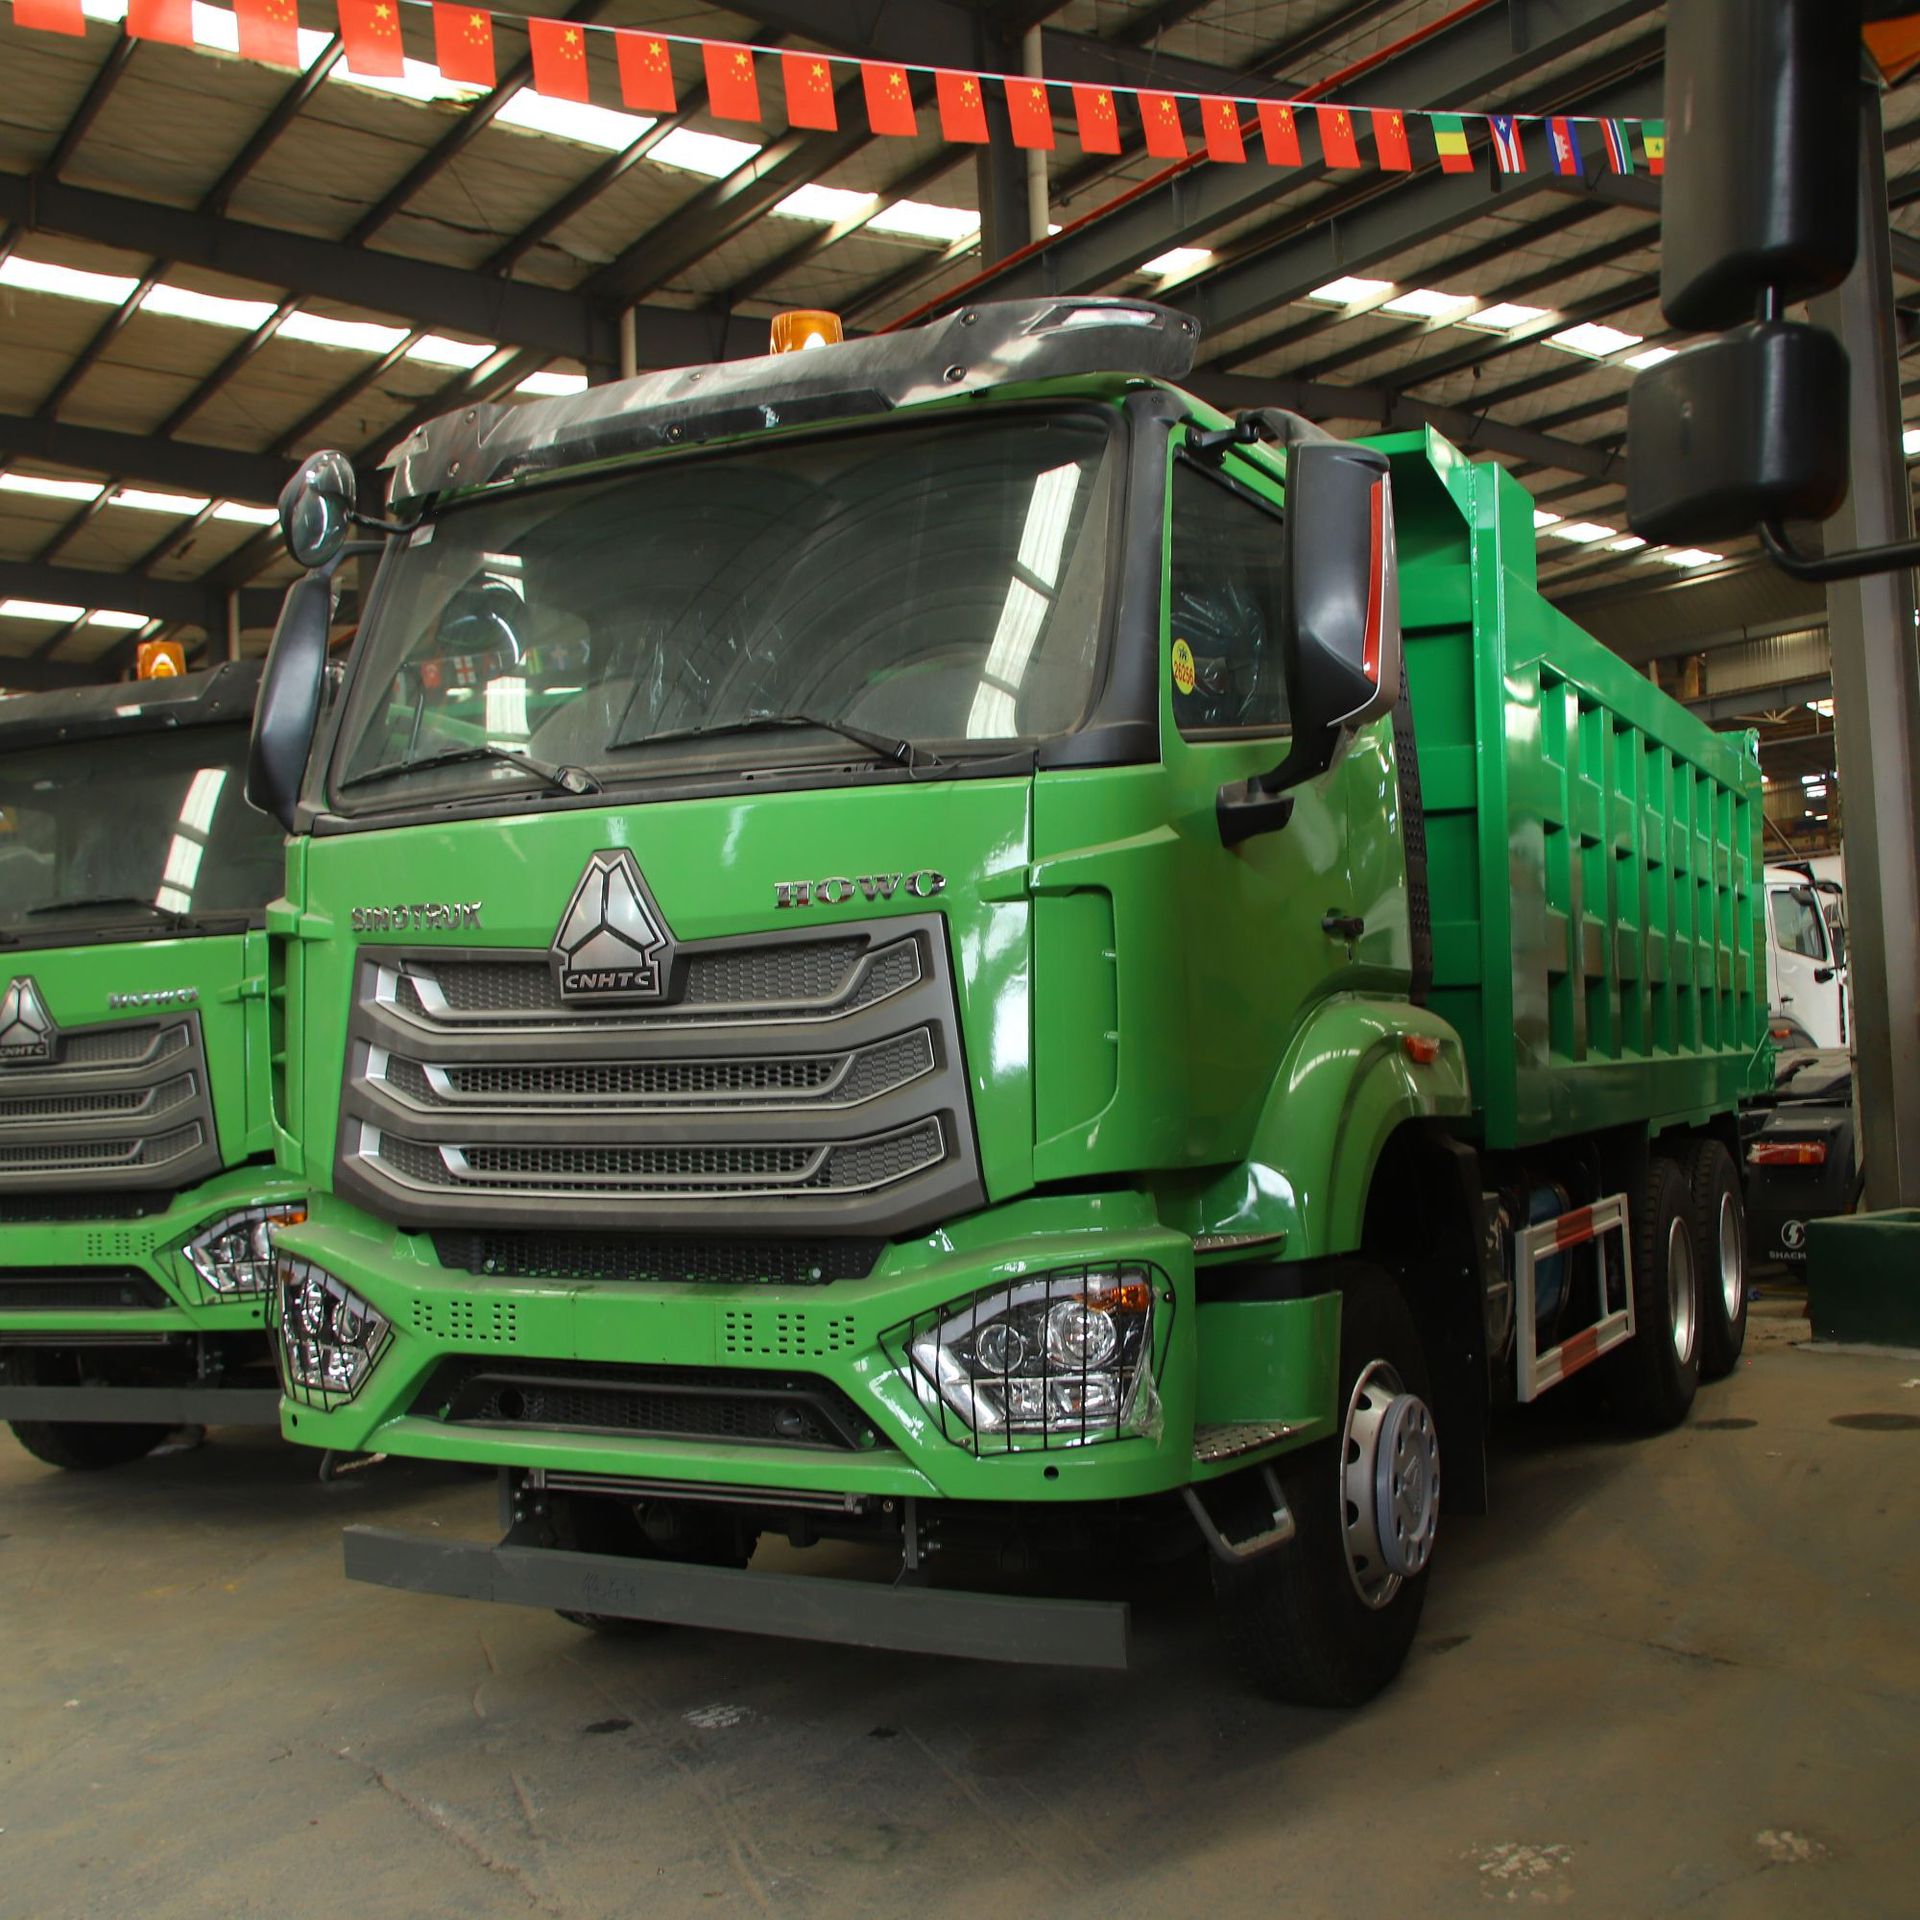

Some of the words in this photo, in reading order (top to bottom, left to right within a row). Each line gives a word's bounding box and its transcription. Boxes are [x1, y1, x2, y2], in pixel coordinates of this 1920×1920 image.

[774, 869, 947, 909] HOWO
[351, 901, 483, 932] SINOTRUK
[564, 969, 651, 991] CNHTC
